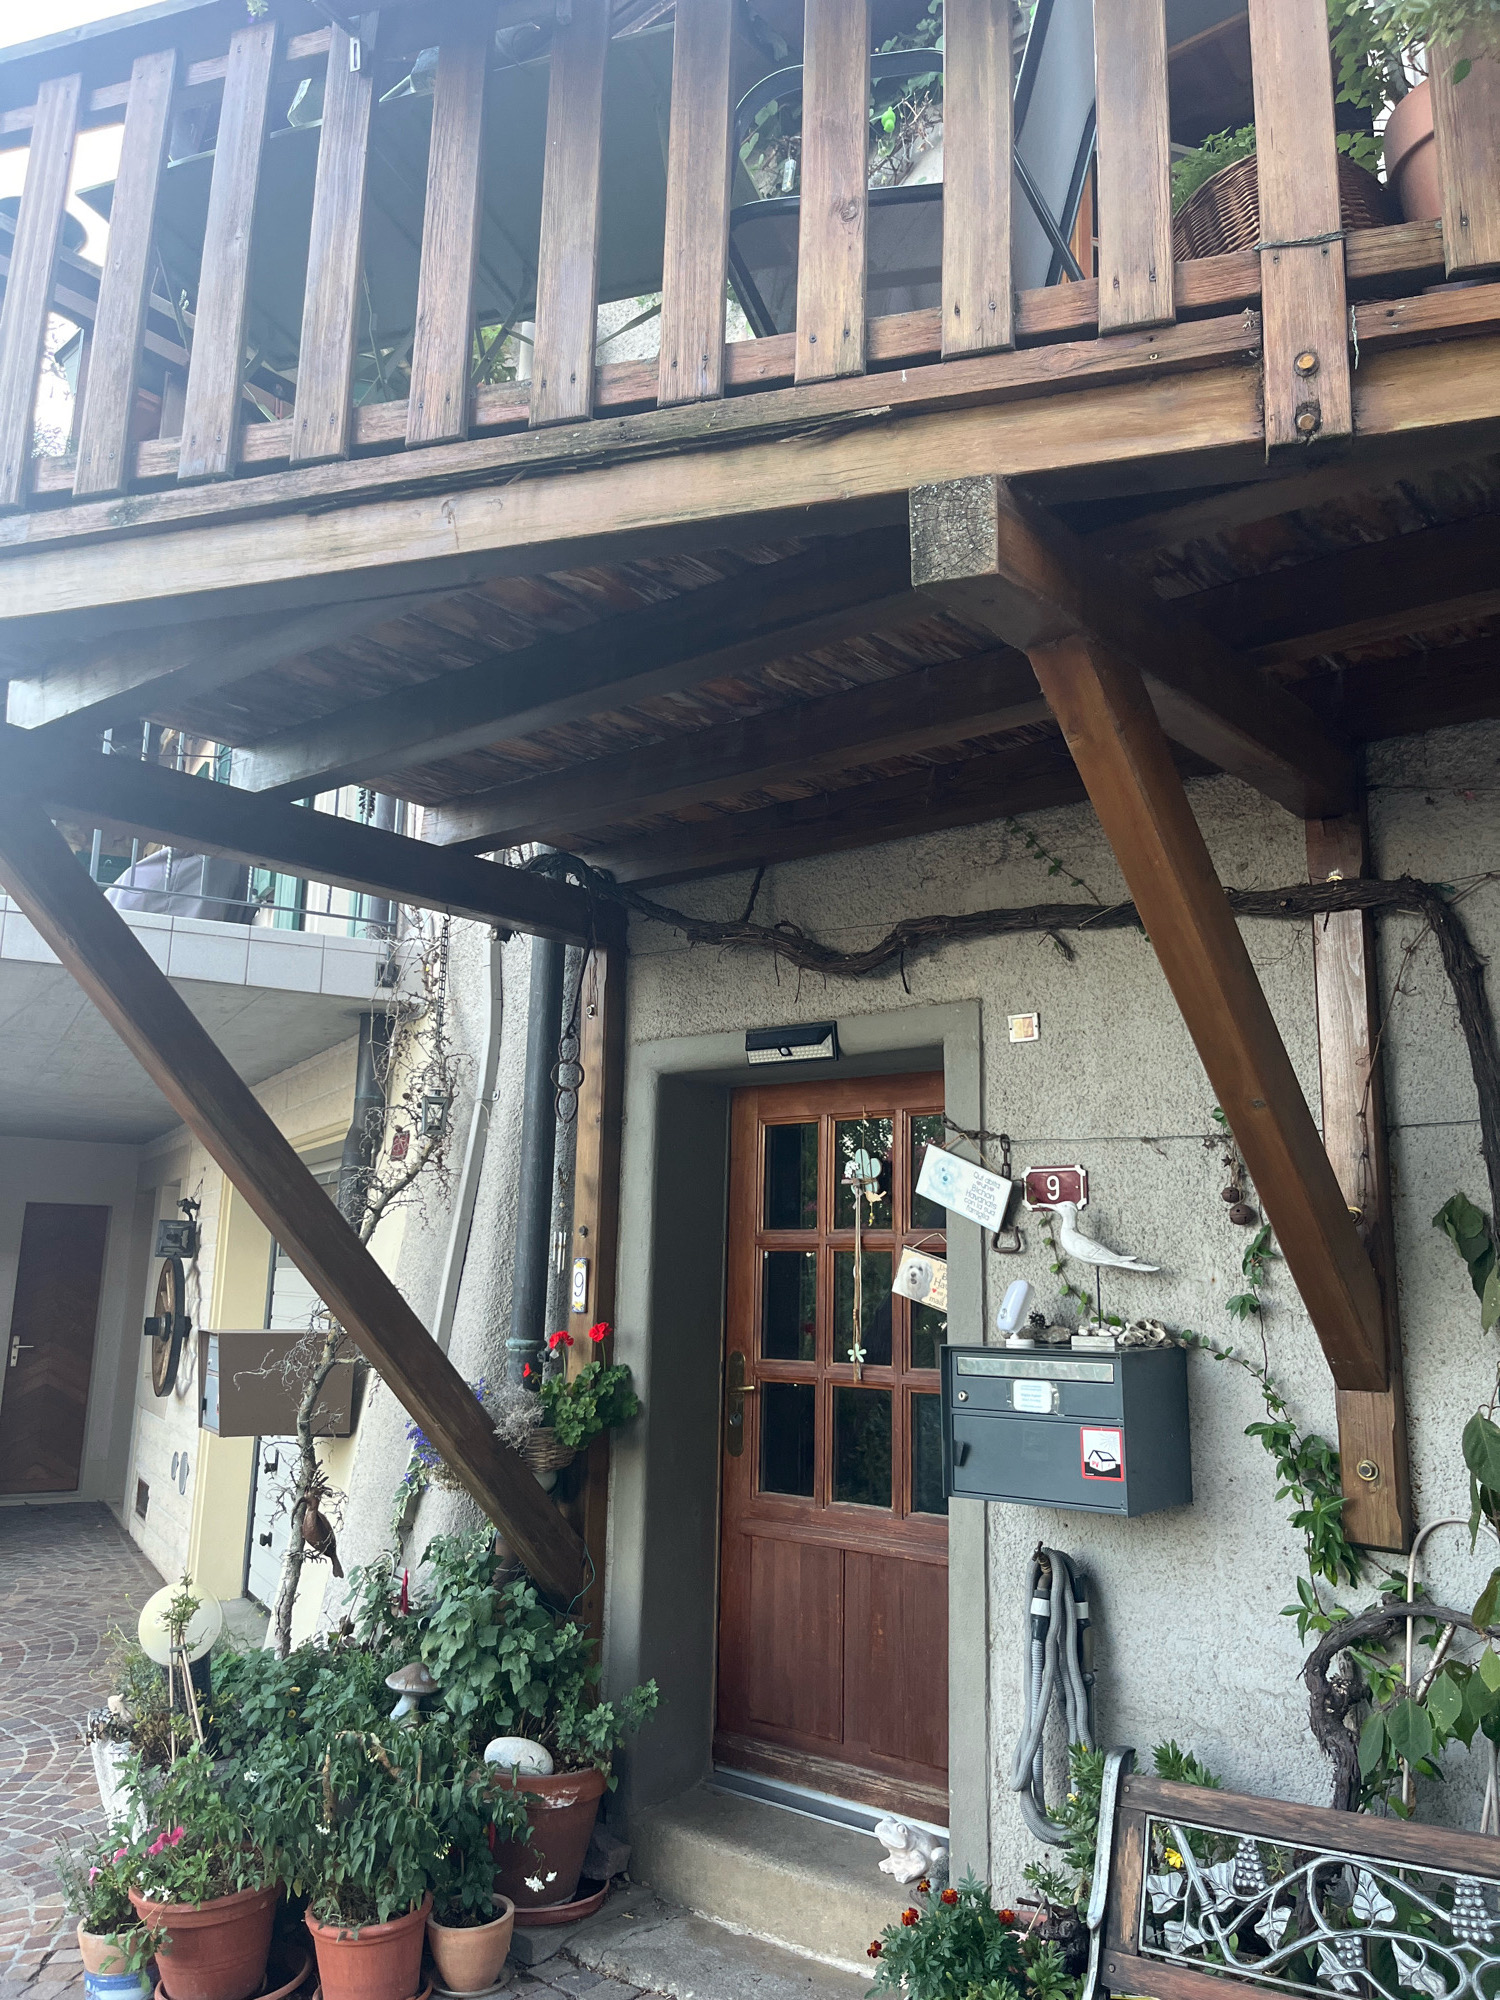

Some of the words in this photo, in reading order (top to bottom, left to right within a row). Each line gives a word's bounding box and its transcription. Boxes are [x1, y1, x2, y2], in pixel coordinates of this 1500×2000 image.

[965, 1188, 997, 1210] Havanais
[971, 1184, 995, 1201] Bichon
[1046, 1175, 1060, 1201] 9
[964, 1197, 976, 1207] con
[976, 1202, 983, 1210] la
[574, 1271, 584, 1297] 9
